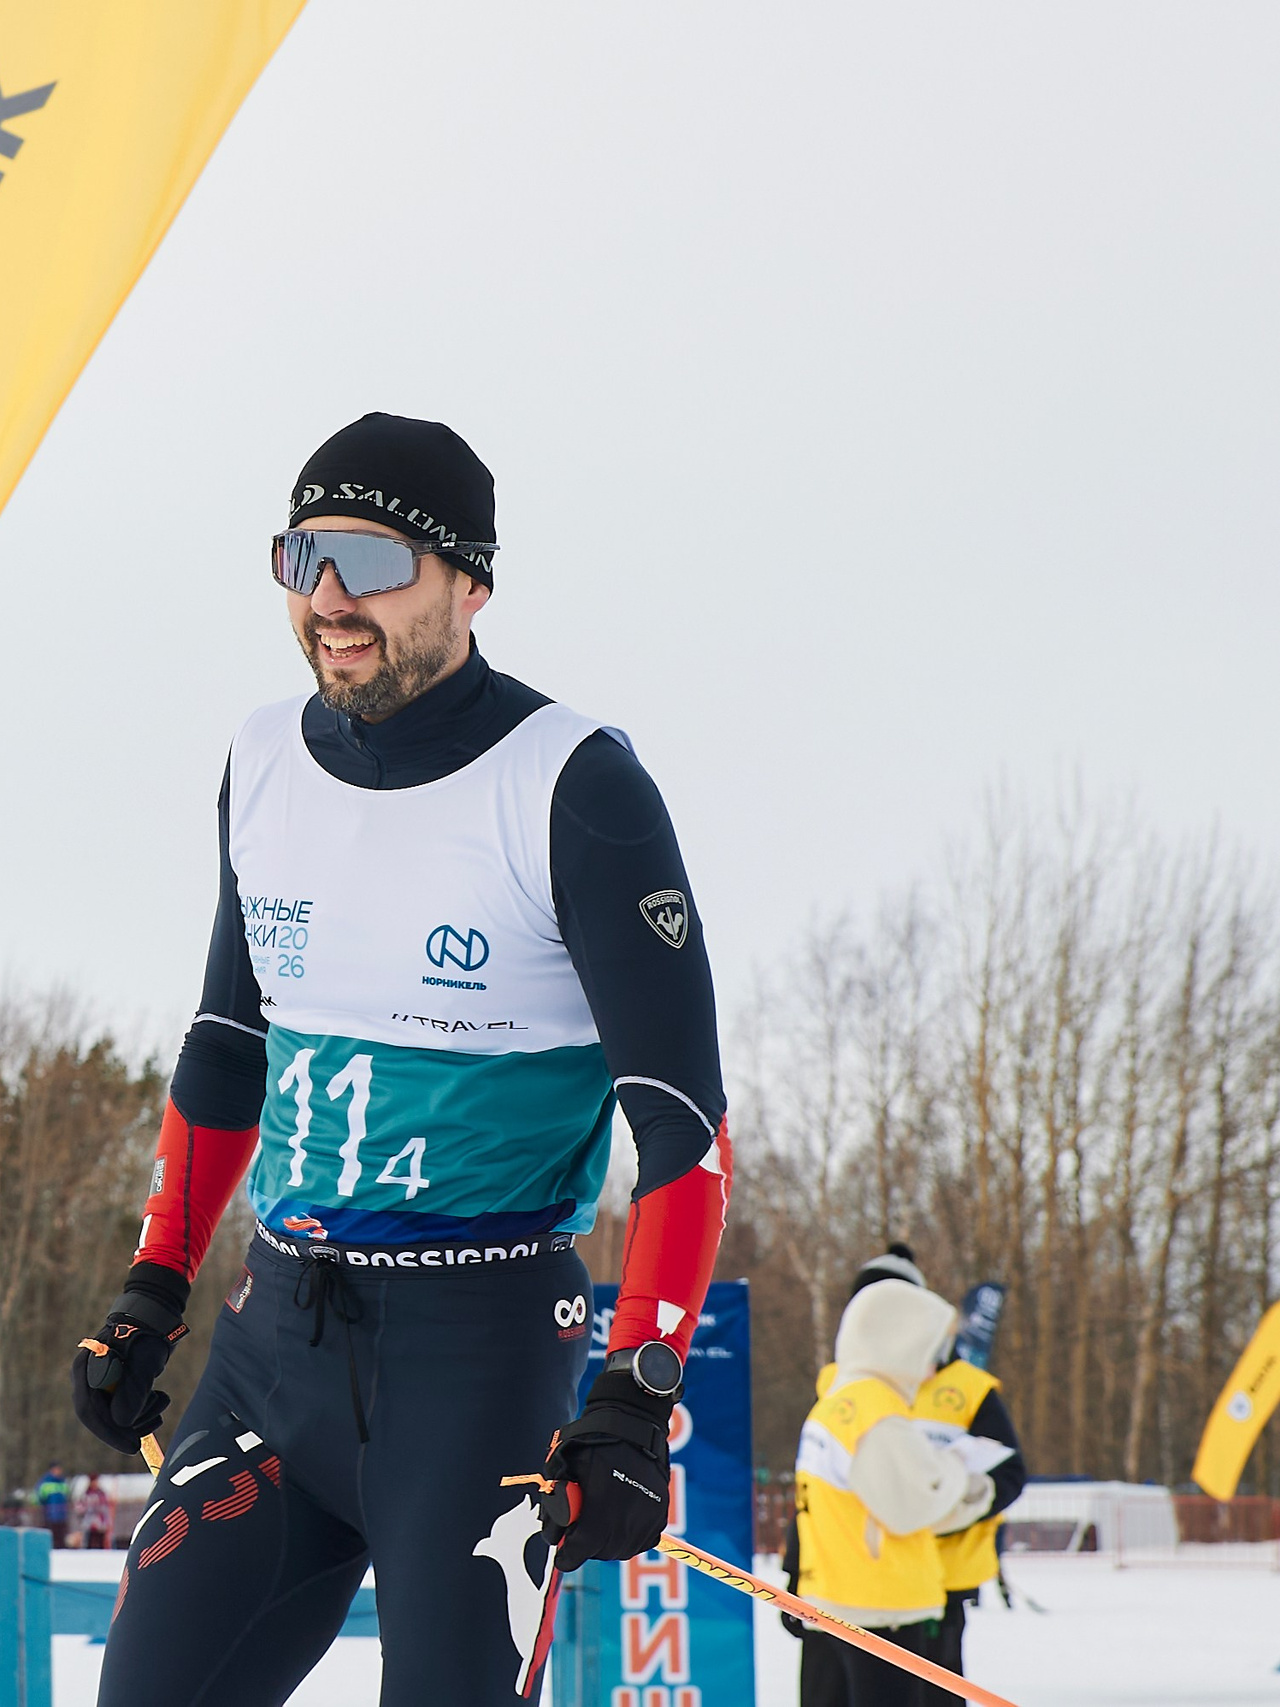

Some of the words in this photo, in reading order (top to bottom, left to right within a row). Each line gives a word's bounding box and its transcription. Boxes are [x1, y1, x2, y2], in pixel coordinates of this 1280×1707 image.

[332, 483, 492, 572] SALOMN
[240, 896, 314, 923] ЫЖНЫЕ
[278, 925, 308, 950] 20
[277, 953, 305, 978] 26
[422, 976, 487, 991] НОРНИКЕЛЬ
[277, 1047, 373, 1197] 11
[375, 1137, 430, 1200] 4
